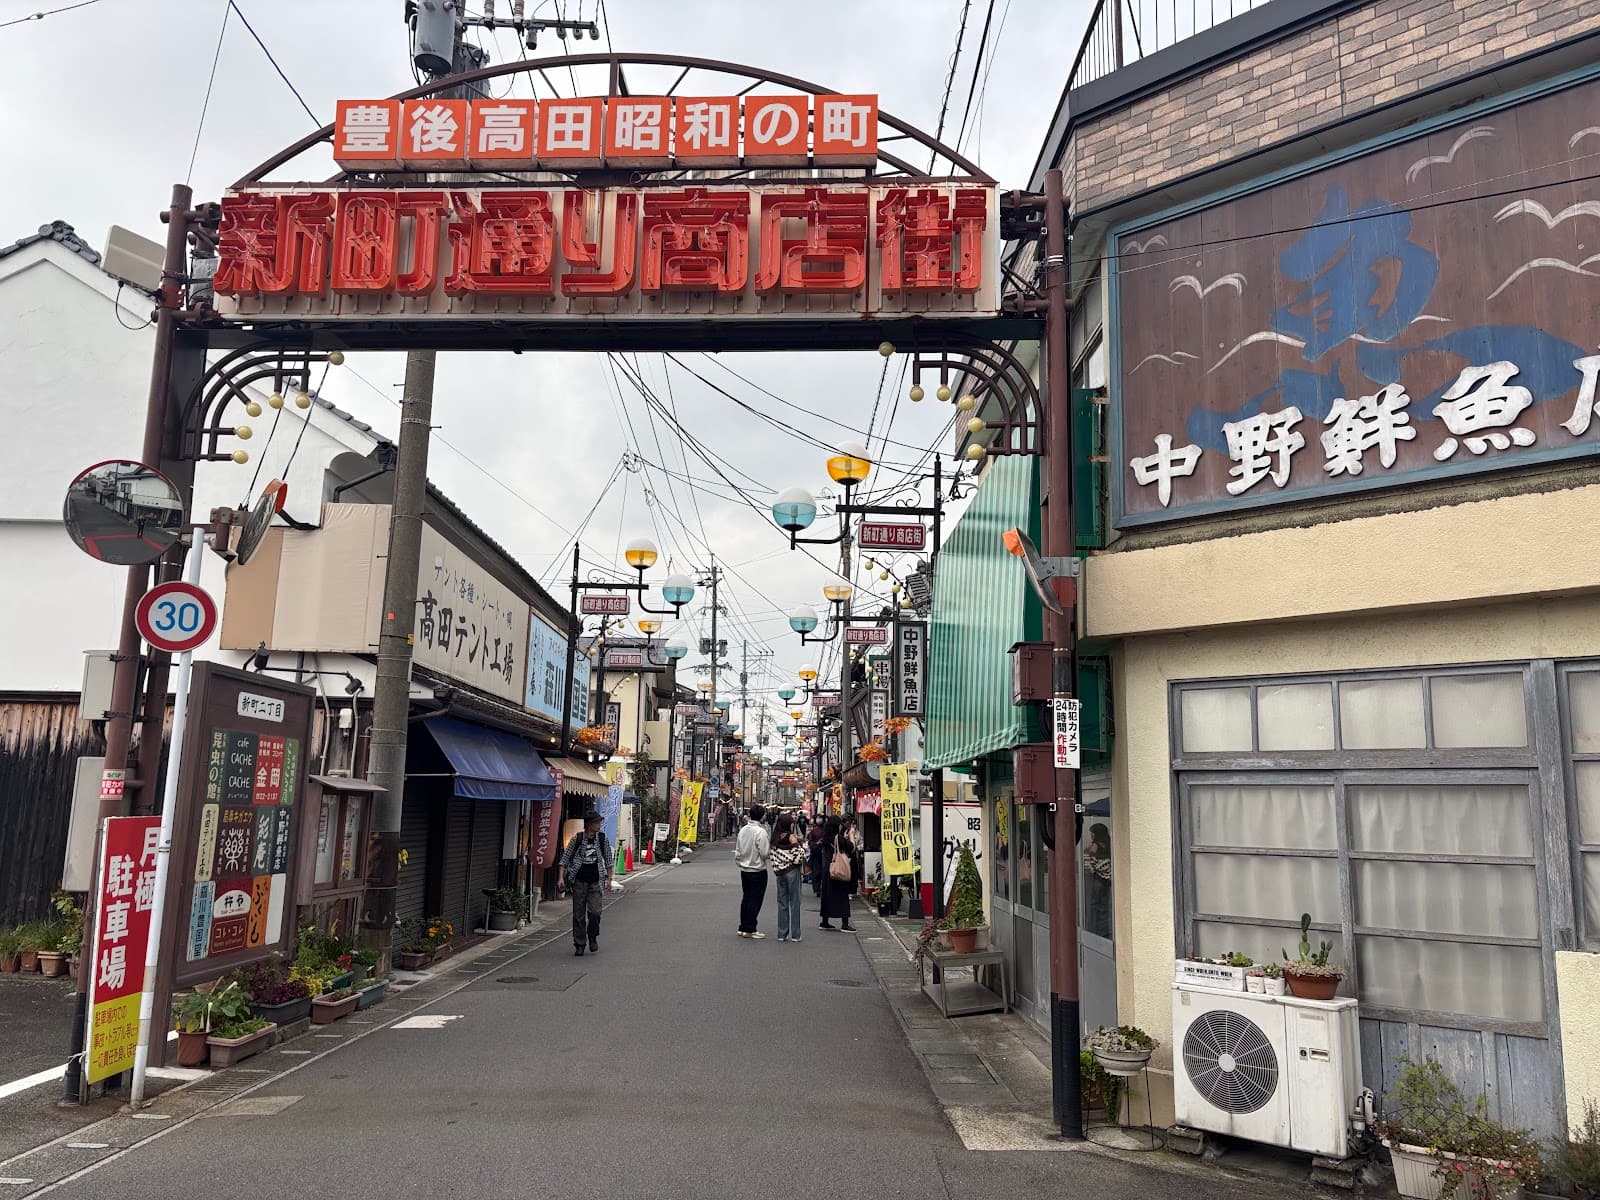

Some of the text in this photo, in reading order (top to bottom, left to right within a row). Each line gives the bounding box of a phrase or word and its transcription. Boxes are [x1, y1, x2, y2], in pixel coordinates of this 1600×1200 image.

[341, 101, 874, 155] 豊後高田昭和の町
[212, 188, 988, 298] 新町通り商店街
[862, 526, 923, 544] 新町通り商店街
[156, 601, 199, 632] 30
[419, 588, 515, 686] 高田テント工場
[903, 628, 918, 711] 中野鮮魚店
[241, 695, 282, 717] 新町二丁目
[1068, 701, 1078, 753] 防犯カメラ
[231, 752, 253, 766] CACHE
[237, 737, 250, 748] cafe
[1055, 700, 1067, 767] 24時間作動中
[206, 731, 223, 800] 昆虫の館
[228, 775, 251, 789] CACHE
[98, 854, 135, 991] 駐車場
